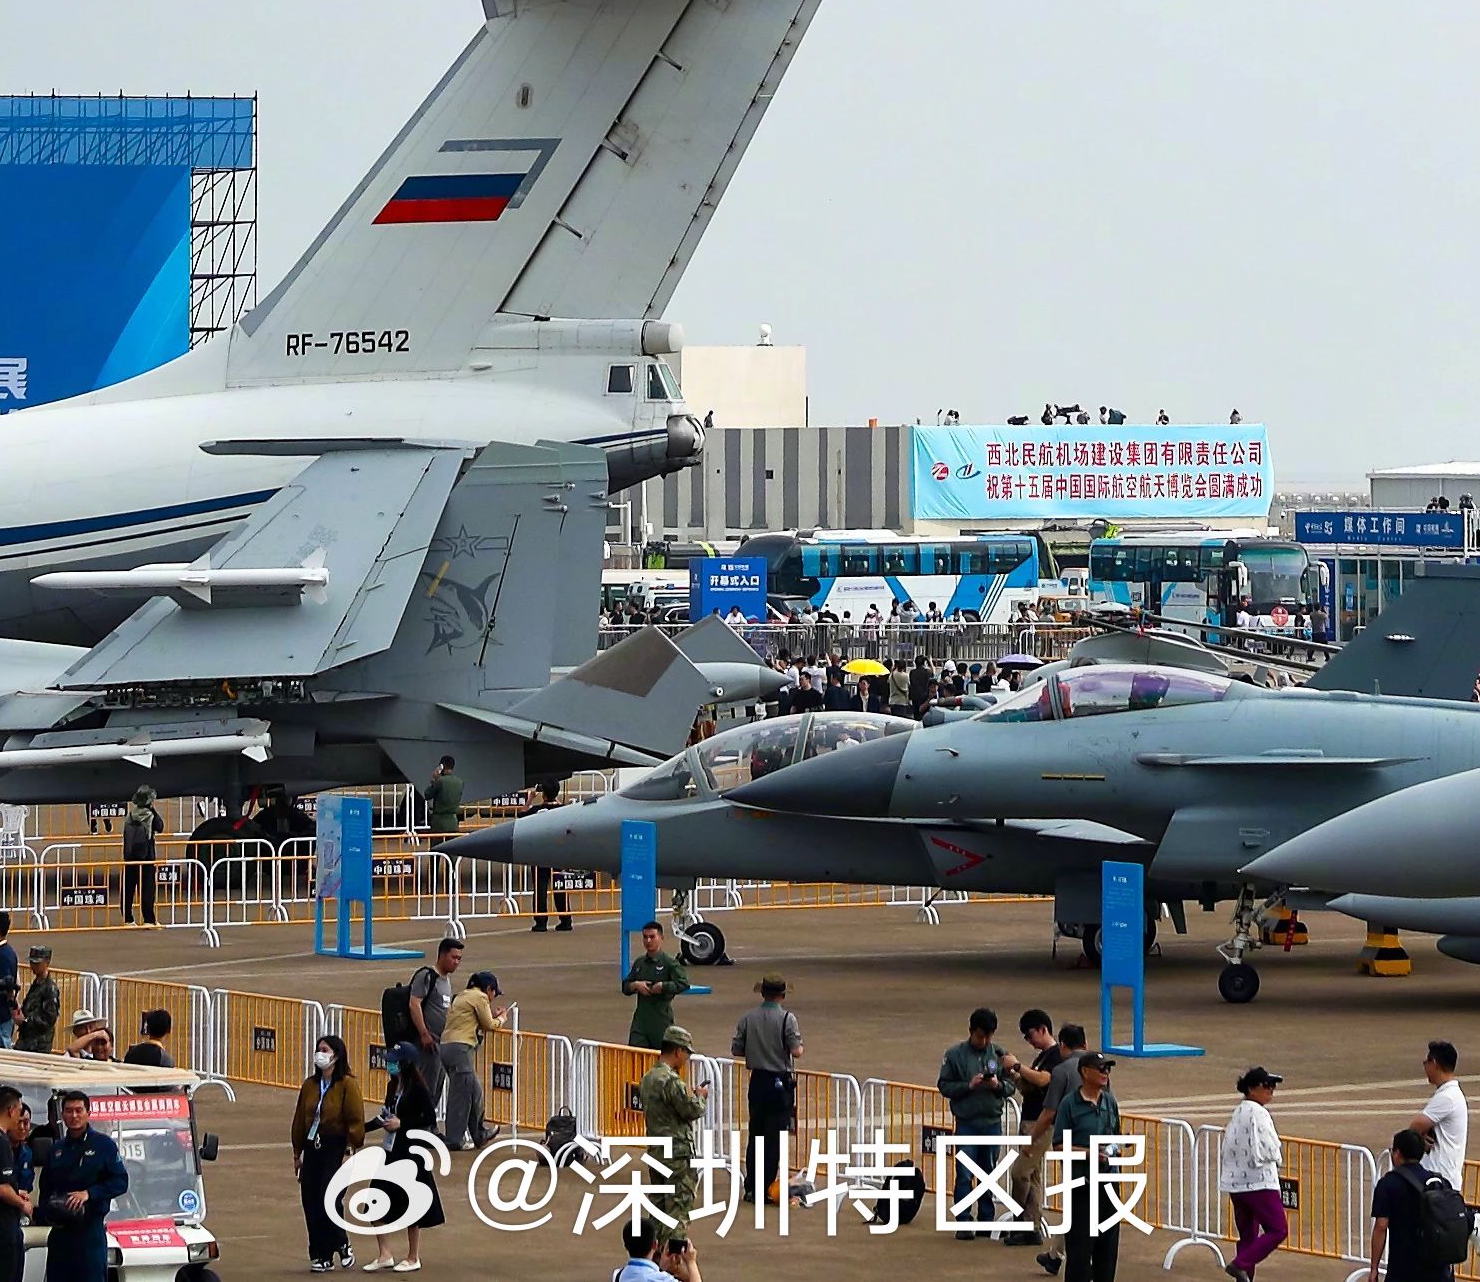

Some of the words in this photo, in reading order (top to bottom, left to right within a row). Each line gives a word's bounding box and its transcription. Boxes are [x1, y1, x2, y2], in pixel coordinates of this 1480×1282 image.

[286, 329, 410, 356] RF-76542
[986, 441, 1263, 467] 西北民航机场建设集团有限责任公司
[986, 472, 1263, 501] 祝第十五届中国国际航空航天博览会圆满成功
[1343, 515, 1406, 535] 媒体工作间
[710, 574, 760, 586] 开幕式入口
[374, 864, 412, 875] 中国珠海
[555, 879, 594, 889] 中国珠海
[64, 894, 105, 905] 中国珠海
